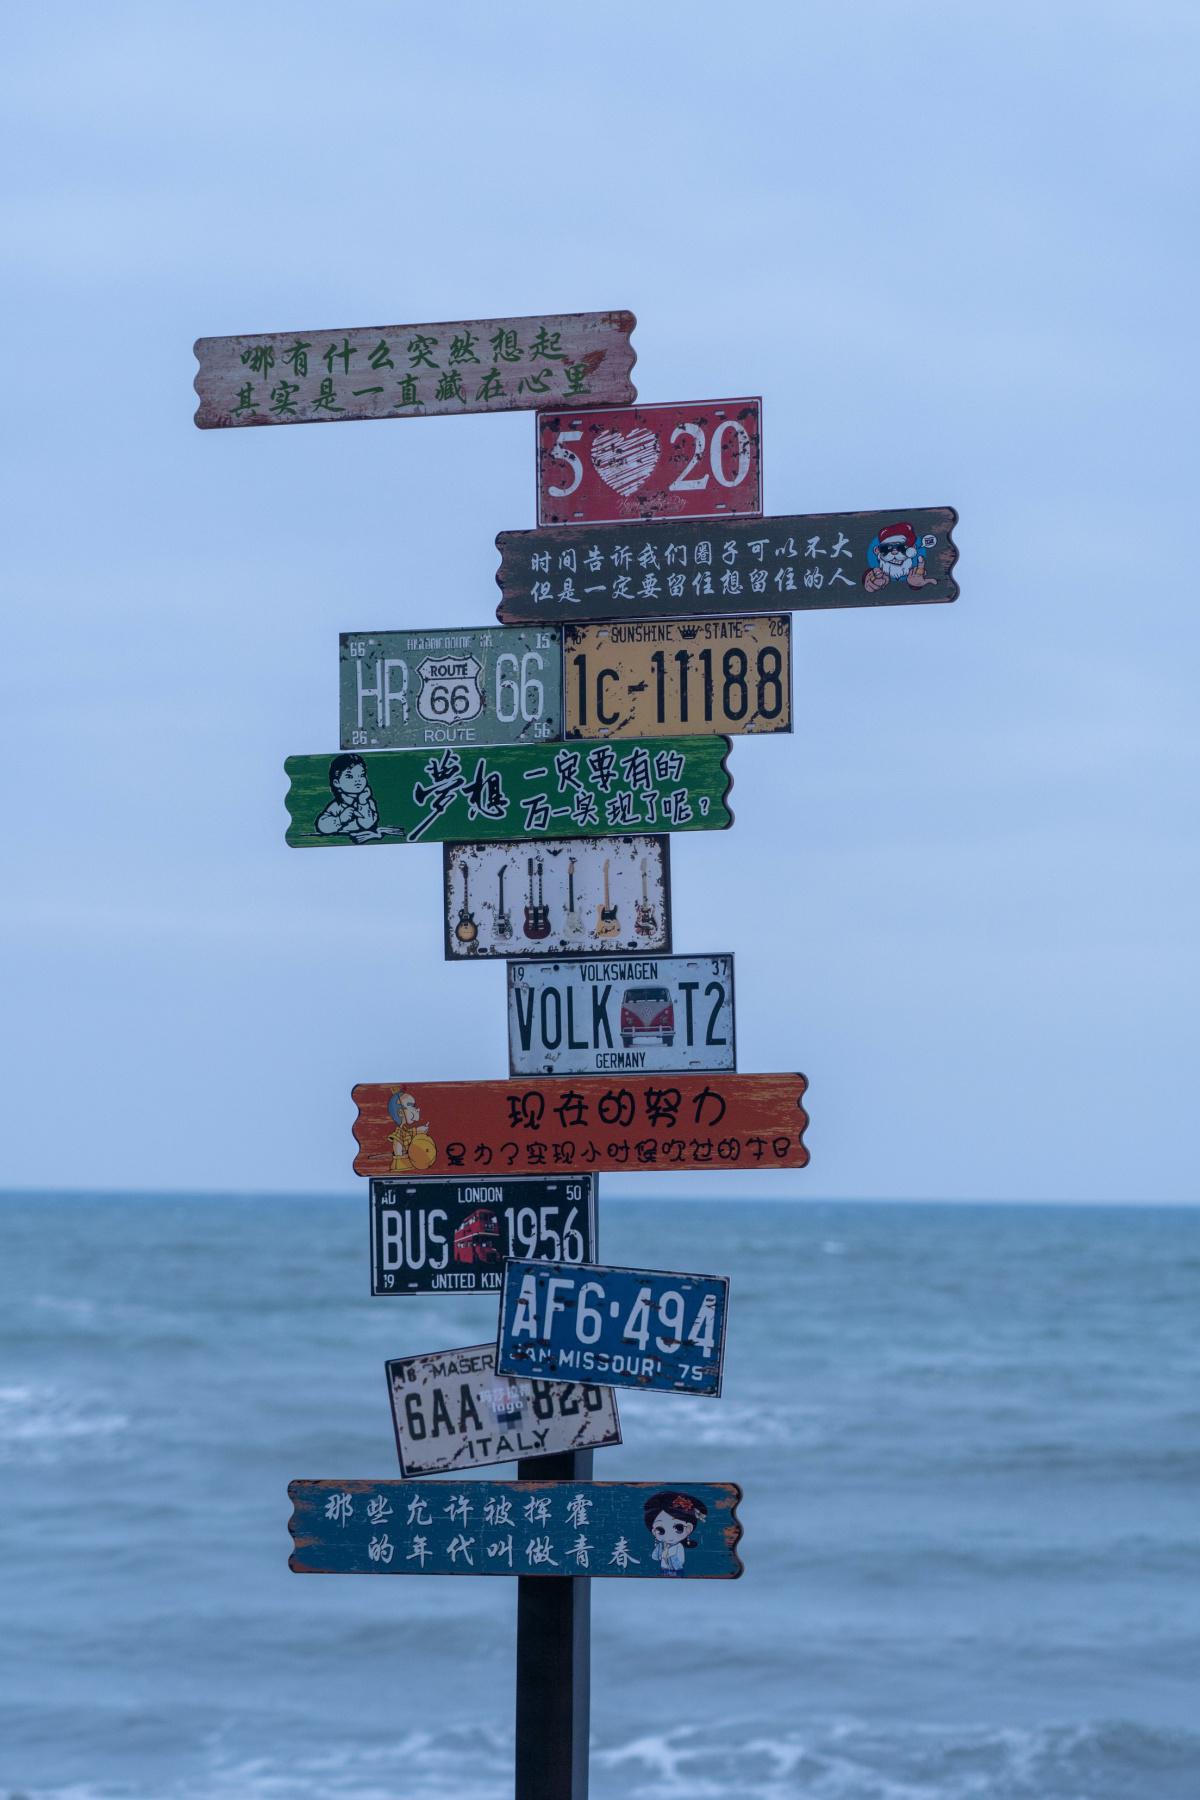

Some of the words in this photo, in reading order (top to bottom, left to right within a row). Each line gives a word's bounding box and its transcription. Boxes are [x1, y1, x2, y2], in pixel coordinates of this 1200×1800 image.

[240, 325, 568, 380] 哪有什么突然想起
[229, 364, 593, 417] 其实是一直藏在心里
[548, 431, 583, 497] 5
[668, 420, 750, 492] 20
[530, 532, 853, 574] 时间告诉我们圈子可以不大
[530, 567, 857, 604] 但是一定要留住想留住的人
[610, 625, 673, 643] SUNSHINE
[704, 621, 743, 639] STATE
[430, 663, 468, 677] ROUTE
[356, 658, 408, 728] HR
[496, 651, 544, 722] 66
[430, 685, 470, 714] 66
[424, 728, 476, 742] ROUTE
[523, 746, 685, 793] 一定要有的
[580, 962, 658, 982] VOLKSWAGEN
[515, 984, 613, 1052] VOLK
[678, 981, 727, 1046] T2
[595, 1052, 646, 1069] GERMANY
[506, 1086, 726, 1129] 现在的努力
[457, 1187, 503, 1203] LONDON
[566, 1185, 581, 1201] 50
[382, 1209, 449, 1271] BUS
[505, 1206, 584, 1263] 1956
[432, 1273, 476, 1289] UNITED
[404, 1383, 482, 1441] 6AA
[467, 1428, 549, 1459] ITALY
[324, 1493, 593, 1530] 那些允许被挥霍
[368, 1533, 641, 1569] 的年代叫做青春
